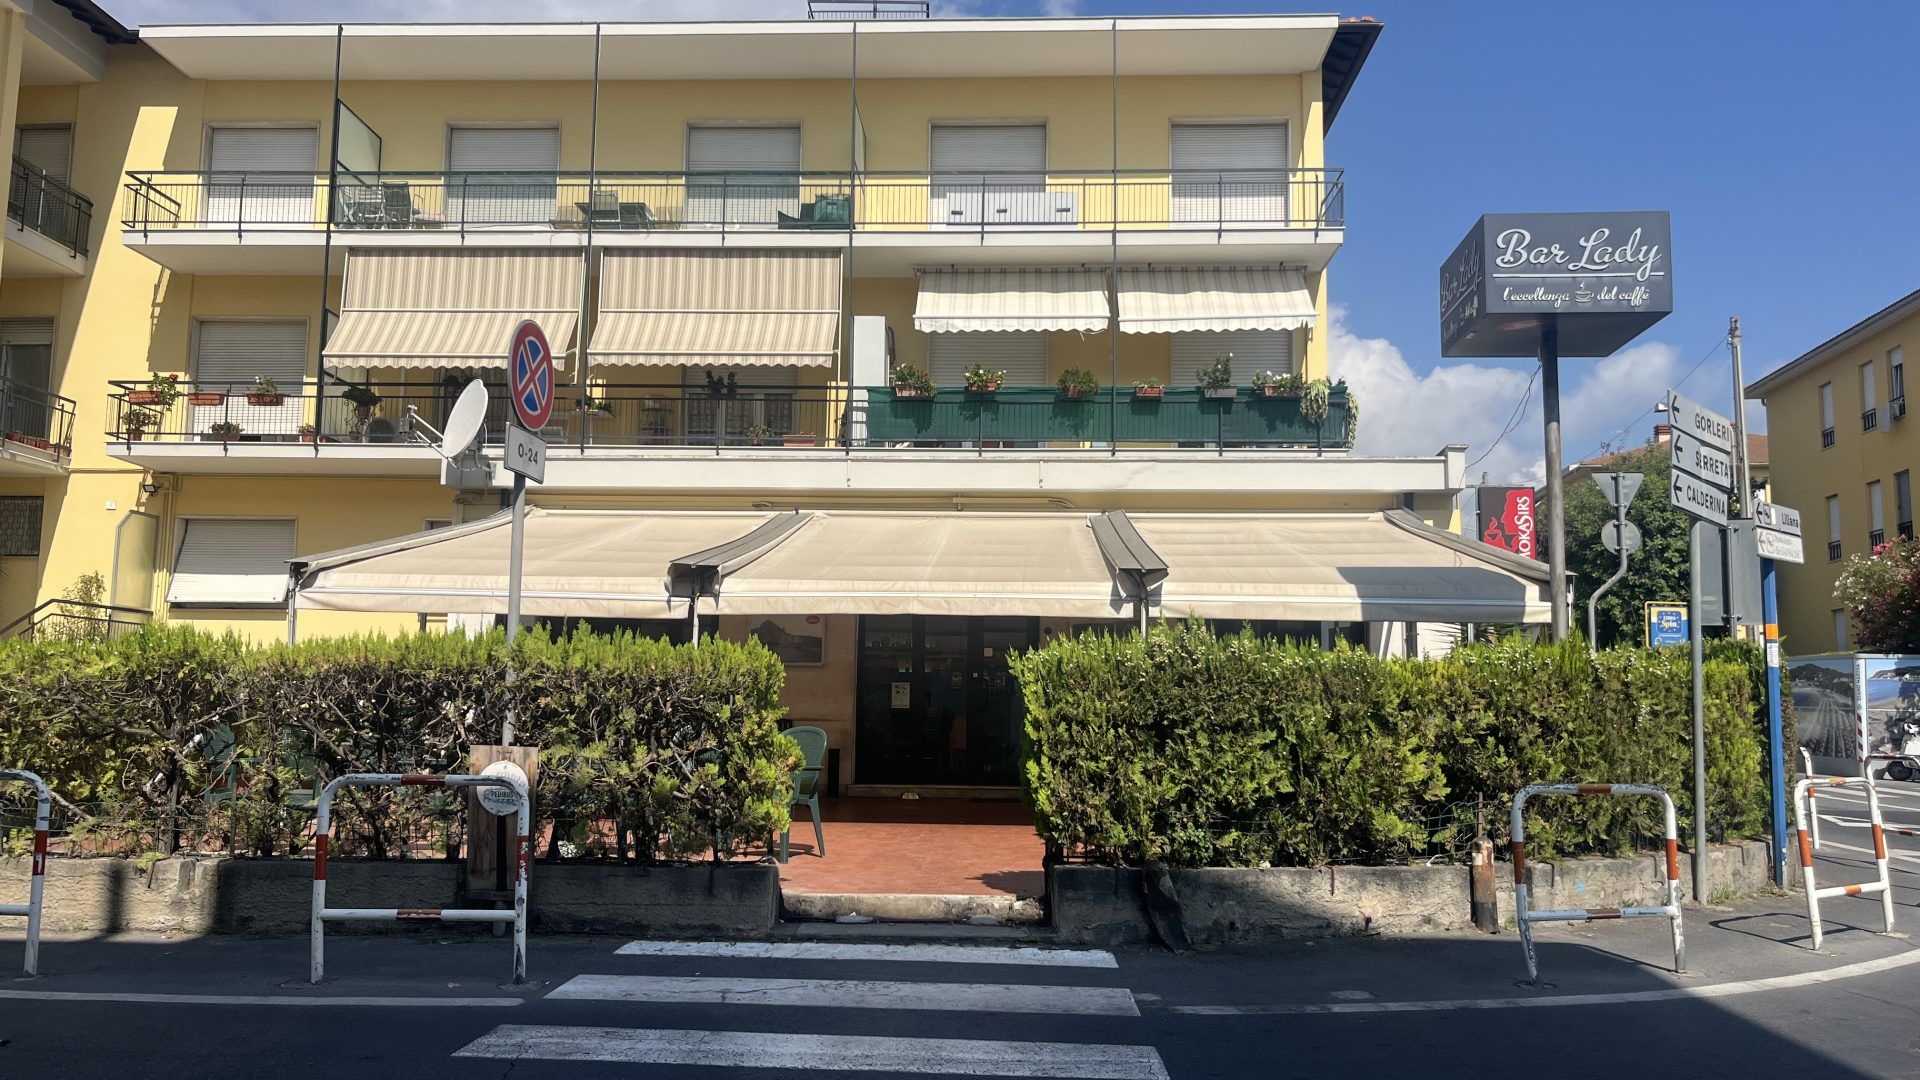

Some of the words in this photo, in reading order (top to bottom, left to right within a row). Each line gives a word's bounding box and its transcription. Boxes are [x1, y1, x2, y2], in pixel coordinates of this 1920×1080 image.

[1495, 228, 1569, 268] Bar
[1568, 227, 1662, 282] Lady
[1597, 286, 1616, 301] del
[1619, 286, 1650, 307] caffè
[1695, 412, 1730, 442] GORLERI
[518, 443, 538, 466] 0-24
[1686, 484, 1726, 517] CALDERINA
[1661, 620, 1677, 629] Spin
[491, 790, 514, 799] PEDIBUS
